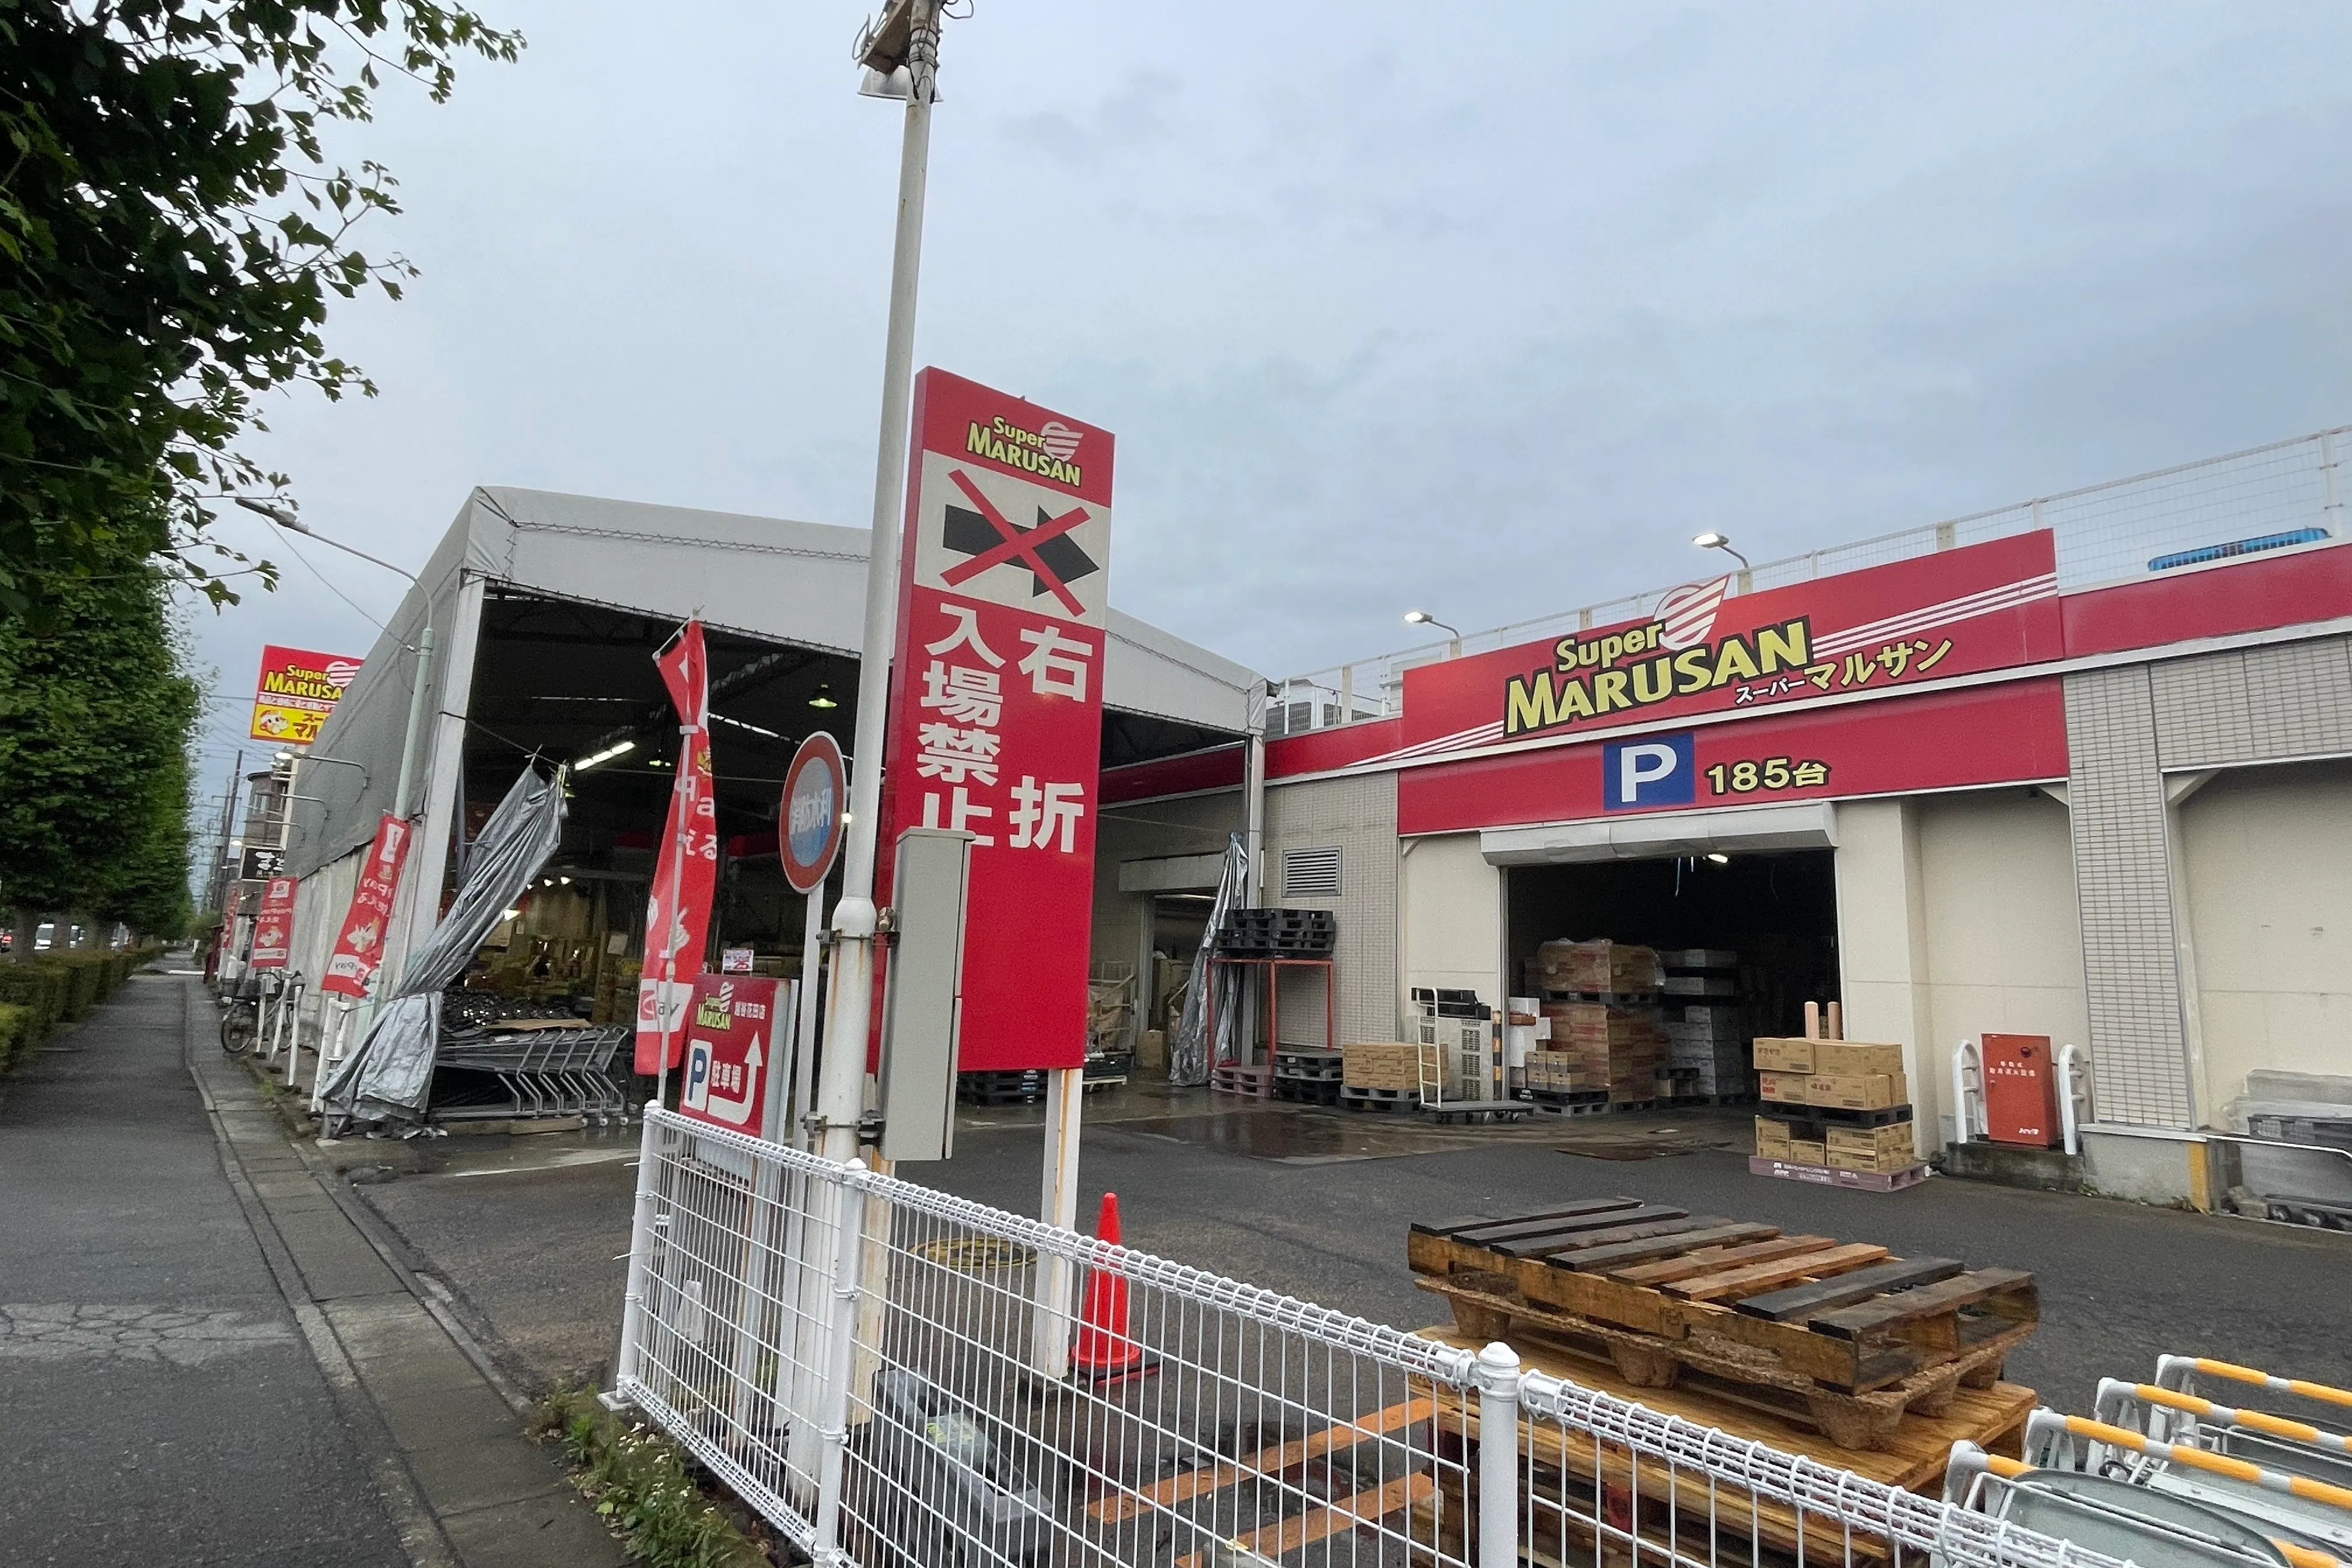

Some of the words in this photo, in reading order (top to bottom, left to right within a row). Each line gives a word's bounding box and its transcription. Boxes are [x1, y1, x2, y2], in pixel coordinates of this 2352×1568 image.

[967, 422, 1082, 487] MARUSAN
[993, 416, 1045, 448] Super
[286, 664, 330, 681] Super
[1556, 621, 1664, 672] Super
[264, 671, 343, 699] MARUSA
[1506, 620, 1810, 736] MARUSAN
[916, 603, 1006, 847] 入場禁止
[1009, 625, 1093, 854] 右折
[1621, 744, 1679, 802] P
[1706, 758, 1829, 795] 185台
[688, 1047, 707, 1101] P
[710, 1060, 741, 1094] 駐車場
